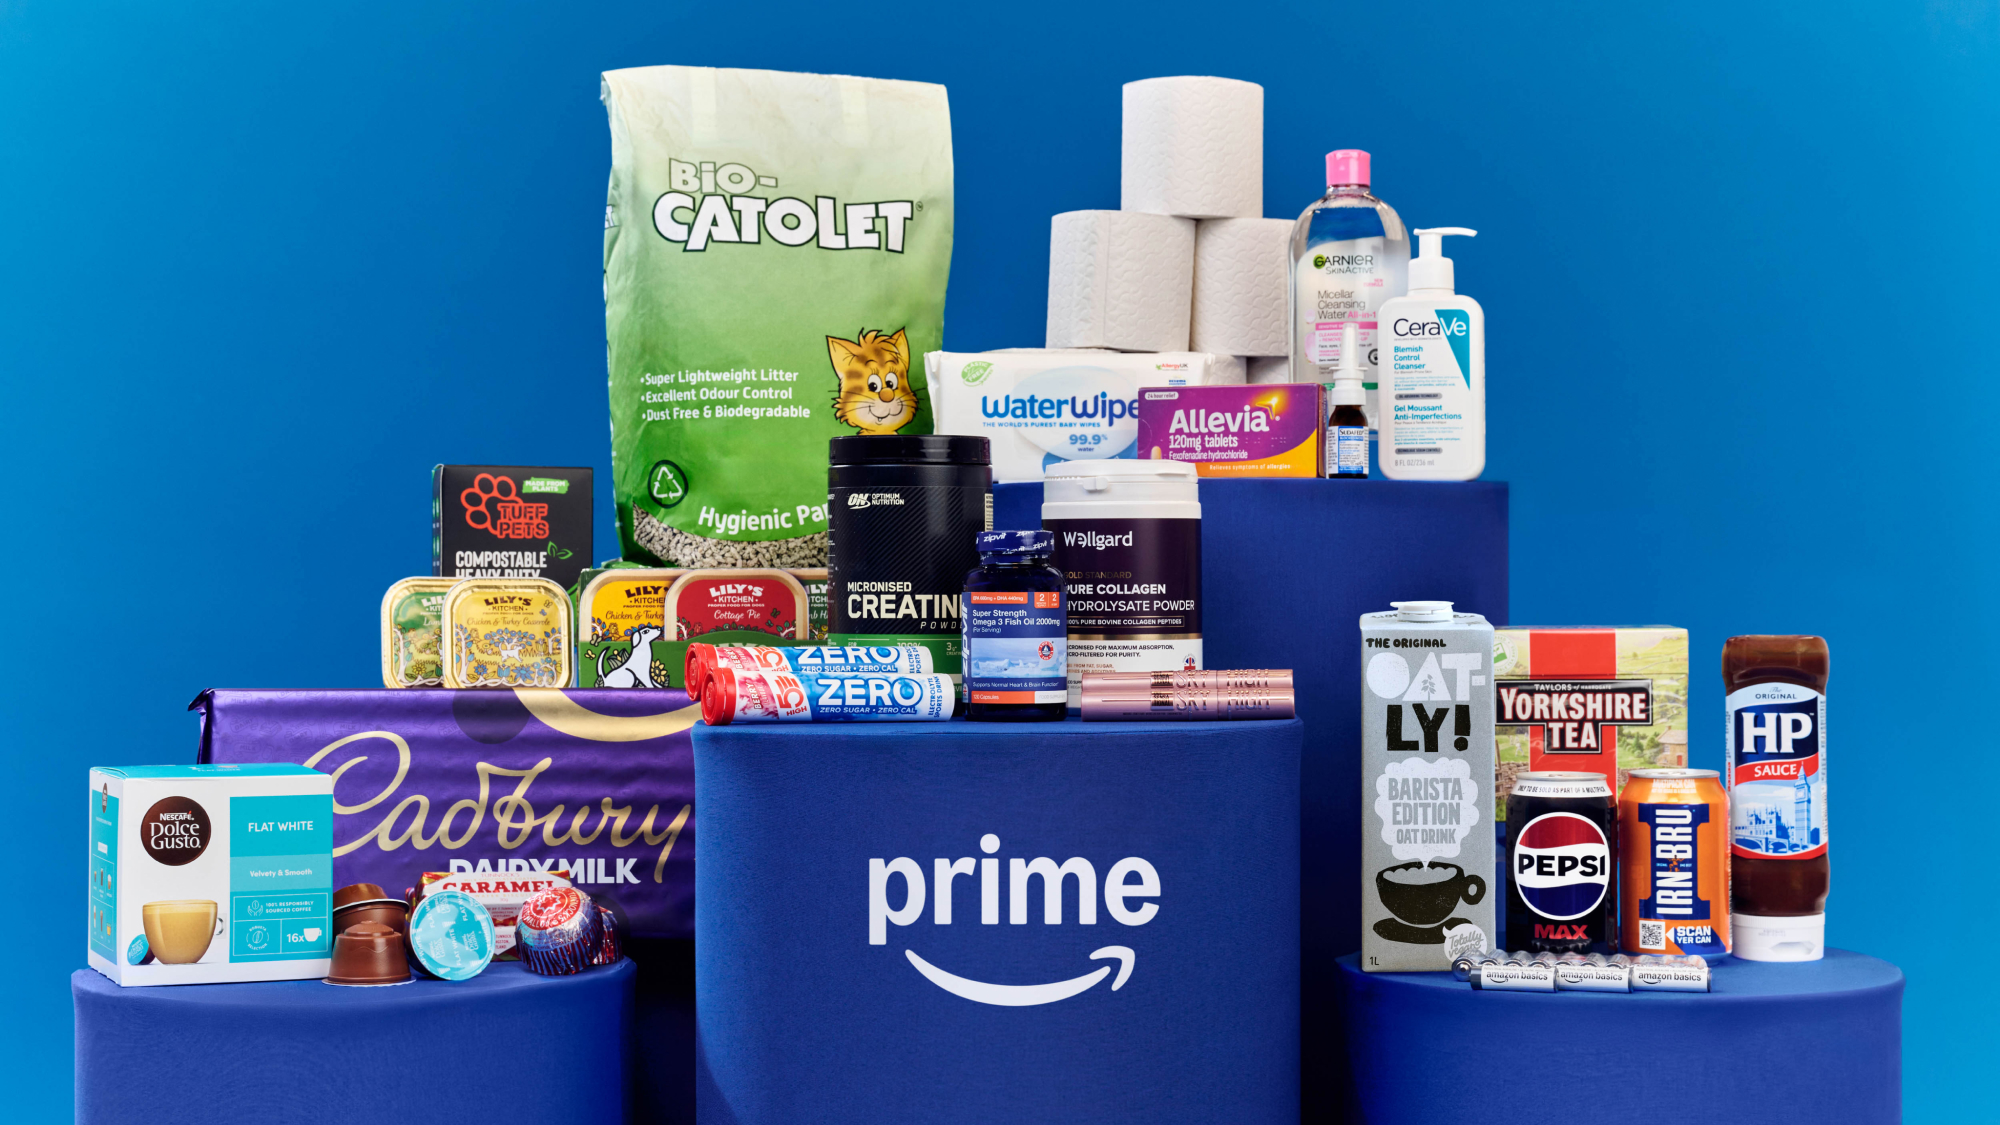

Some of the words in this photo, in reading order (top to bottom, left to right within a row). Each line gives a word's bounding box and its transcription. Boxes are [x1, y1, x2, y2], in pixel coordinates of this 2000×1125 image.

[652, 191, 913, 254] CATOLET
[1318, 290, 1354, 299] Micellar
[1318, 300, 1365, 310] Cleansing
[1318, 311, 1347, 320] Water
[1394, 317, 1466, 336] CeraVe
[646, 373, 675, 385] Super
[678, 370, 757, 384] Lightweight
[760, 369, 798, 382] Litter
[646, 390, 696, 403] Excellent
[700, 388, 738, 400] Odour
[743, 387, 792, 399] Control
[647, 409, 670, 421] Dust
[673, 408, 699, 419] Free
[703, 408, 712, 418] &
[715, 406, 810, 420] Biodegradable
[1169, 405, 1269, 433] Allevia
[1394, 413, 1462, 421] Anti-Imperfections
[1069, 434, 1108, 445] 99.9%
[1169, 434, 1201, 451] 120mg
[1205, 434, 1238, 447] tablets
[1169, 450, 1207, 460] Fexofenadine
[1208, 450, 1248, 461] hydrochloride
[497, 503, 548, 520] TUFF
[699, 506, 792, 534] Hygienic
[497, 520, 549, 539] PETS
[456, 551, 547, 567] COMPOSTABLE
[710, 584, 763, 597] LILY'S
[848, 582, 911, 592] MICRONISED
[1097, 584, 1166, 594] COLLAGEN
[848, 594, 962, 618] CREATIN
[993, 609, 1027, 617] Strength
[1153, 600, 1194, 611] POWDER
[467, 617, 491, 625] Chicken
[502, 617, 520, 626] Turkey
[523, 617, 550, 625] Casserole
[606, 610, 633, 620] Chicken
[714, 609, 744, 621] Cottage
[747, 609, 760, 618] Pie
[973, 618, 996, 626] Omega
[1036, 618, 1060, 626] 2000mg
[1366, 638, 1390, 648] THE
[1393, 638, 1446, 648] ORIGINAL
[746, 682, 762, 709] BERRY
[818, 678, 921, 706] ZERO
[786, 706, 807, 716] HIGH
[934, 694, 943, 718] SPORTS
[1499, 687, 1647, 720] YORKSHIRE
[1386, 703, 1471, 752] LY!
[1741, 712, 1813, 753] HP
[1547, 722, 1598, 749] TEA
[1754, 764, 1797, 777] SAUCE
[1388, 777, 1463, 800] BARISTA
[302, 730, 692, 884] Cadbury
[1392, 802, 1460, 825] EDITION
[150, 822, 199, 836] Dolce
[248, 822, 274, 832] FLAT
[278, 821, 313, 831] WHITE
[151, 835, 200, 850] Gusto
[1396, 829, 1420, 844] OAT
[1421, 829, 1456, 844] DRINK
[558, 858, 641, 884] MILK
[1518, 853, 1605, 877] PEPSI
[250, 870, 276, 878] Velvety
[868, 833, 1161, 945] prime
[287, 933, 304, 942] 16x
[1535, 924, 1589, 939] MAX
[1677, 926, 1711, 936] SCAN
[1449, 931, 1484, 947] Totally
[1369, 957, 1379, 965] 1L
[1486, 970, 1519, 980] amazon
[1521, 971, 1548, 981] basics
[1561, 971, 1594, 979] amazon
[1595, 971, 1623, 981] basics
[1638, 972, 1672, 980] amazon
[1674, 972, 1702, 981] basics
